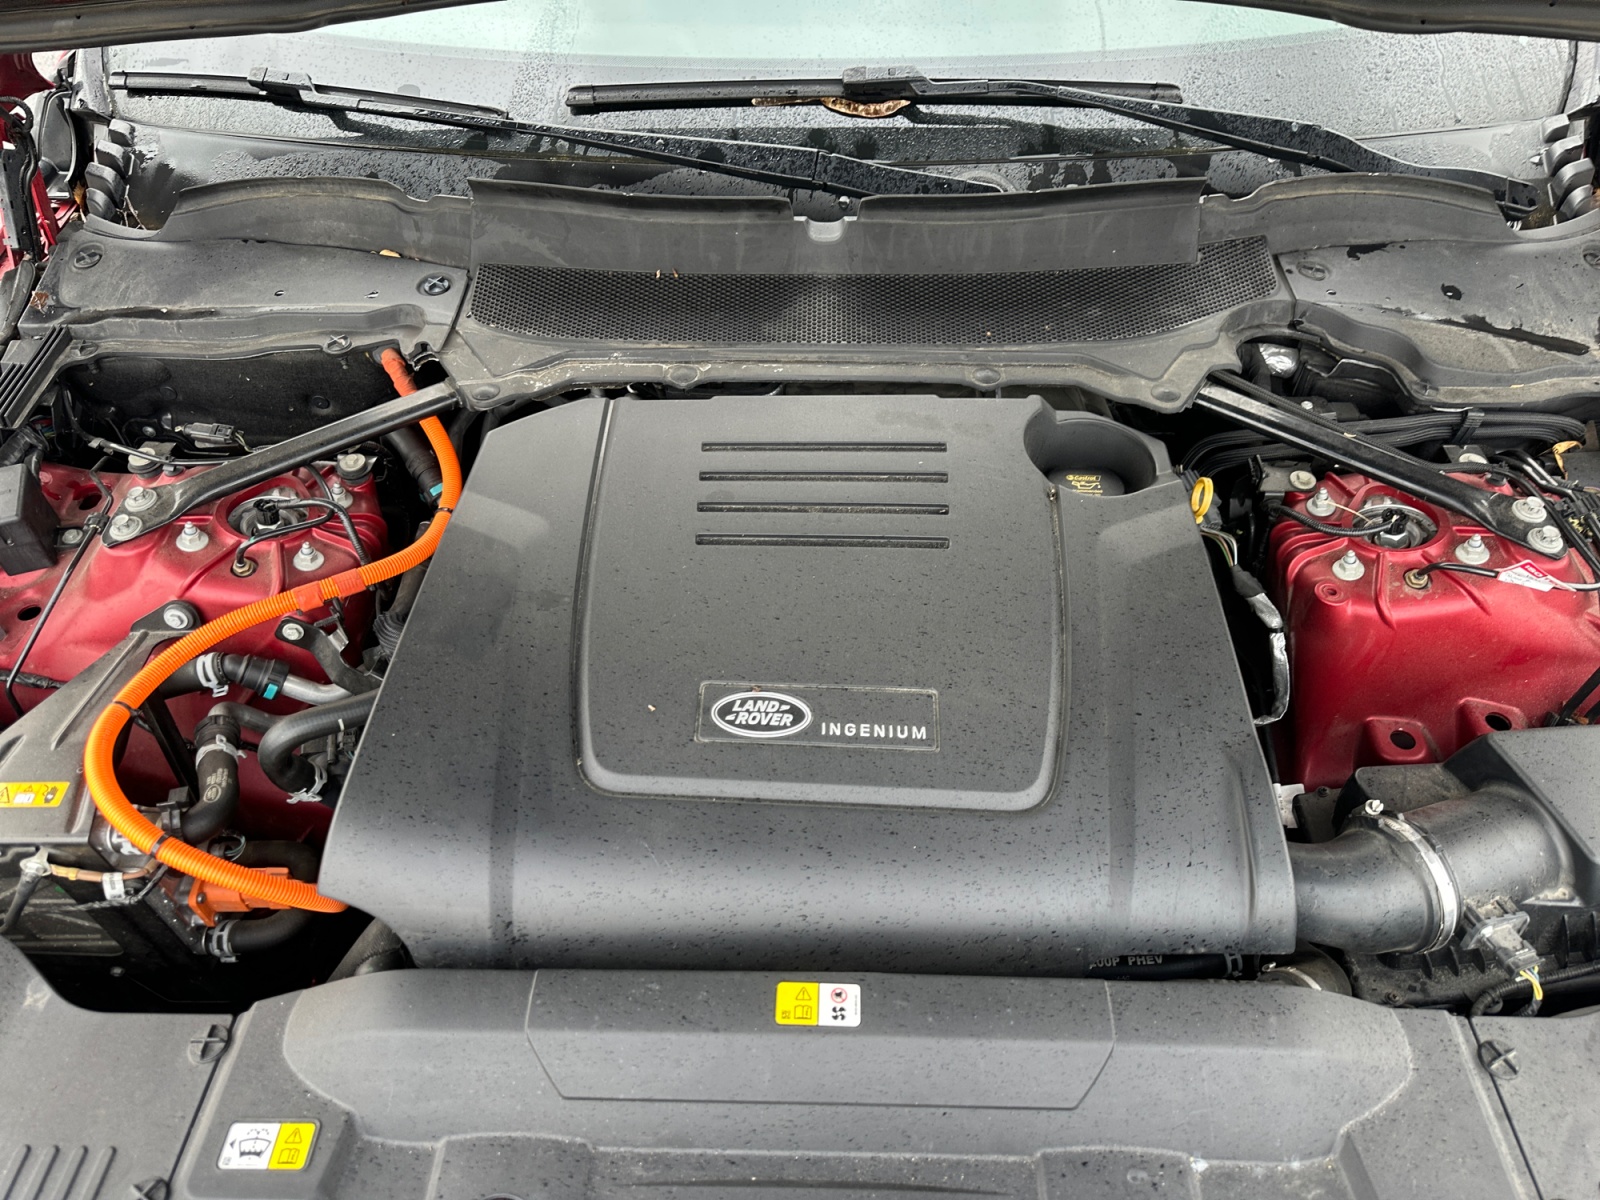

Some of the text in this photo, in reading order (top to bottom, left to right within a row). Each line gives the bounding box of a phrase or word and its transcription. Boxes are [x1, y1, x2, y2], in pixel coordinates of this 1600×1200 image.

[732, 700, 780, 713] LAND
[734, 712, 794, 727] ROVER
[821, 722, 927, 740] INGENIUM
[1127, 955, 1163, 966] PHEV
